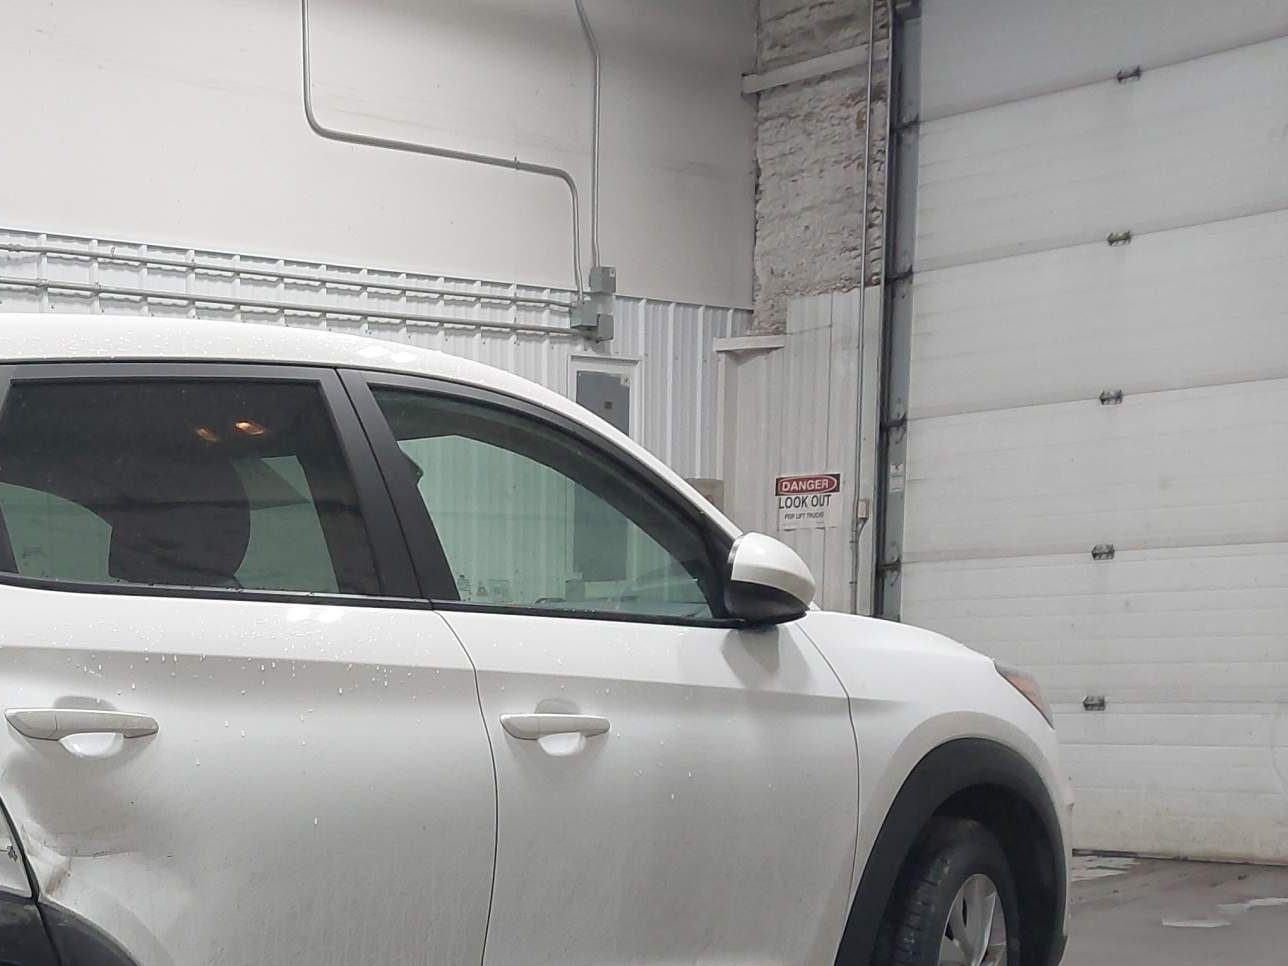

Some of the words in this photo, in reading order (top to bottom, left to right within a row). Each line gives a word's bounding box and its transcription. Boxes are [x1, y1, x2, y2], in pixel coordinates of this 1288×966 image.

[782, 479, 828, 491] DANGER
[779, 495, 809, 509] LOOK
[811, 493, 832, 507] OUT
